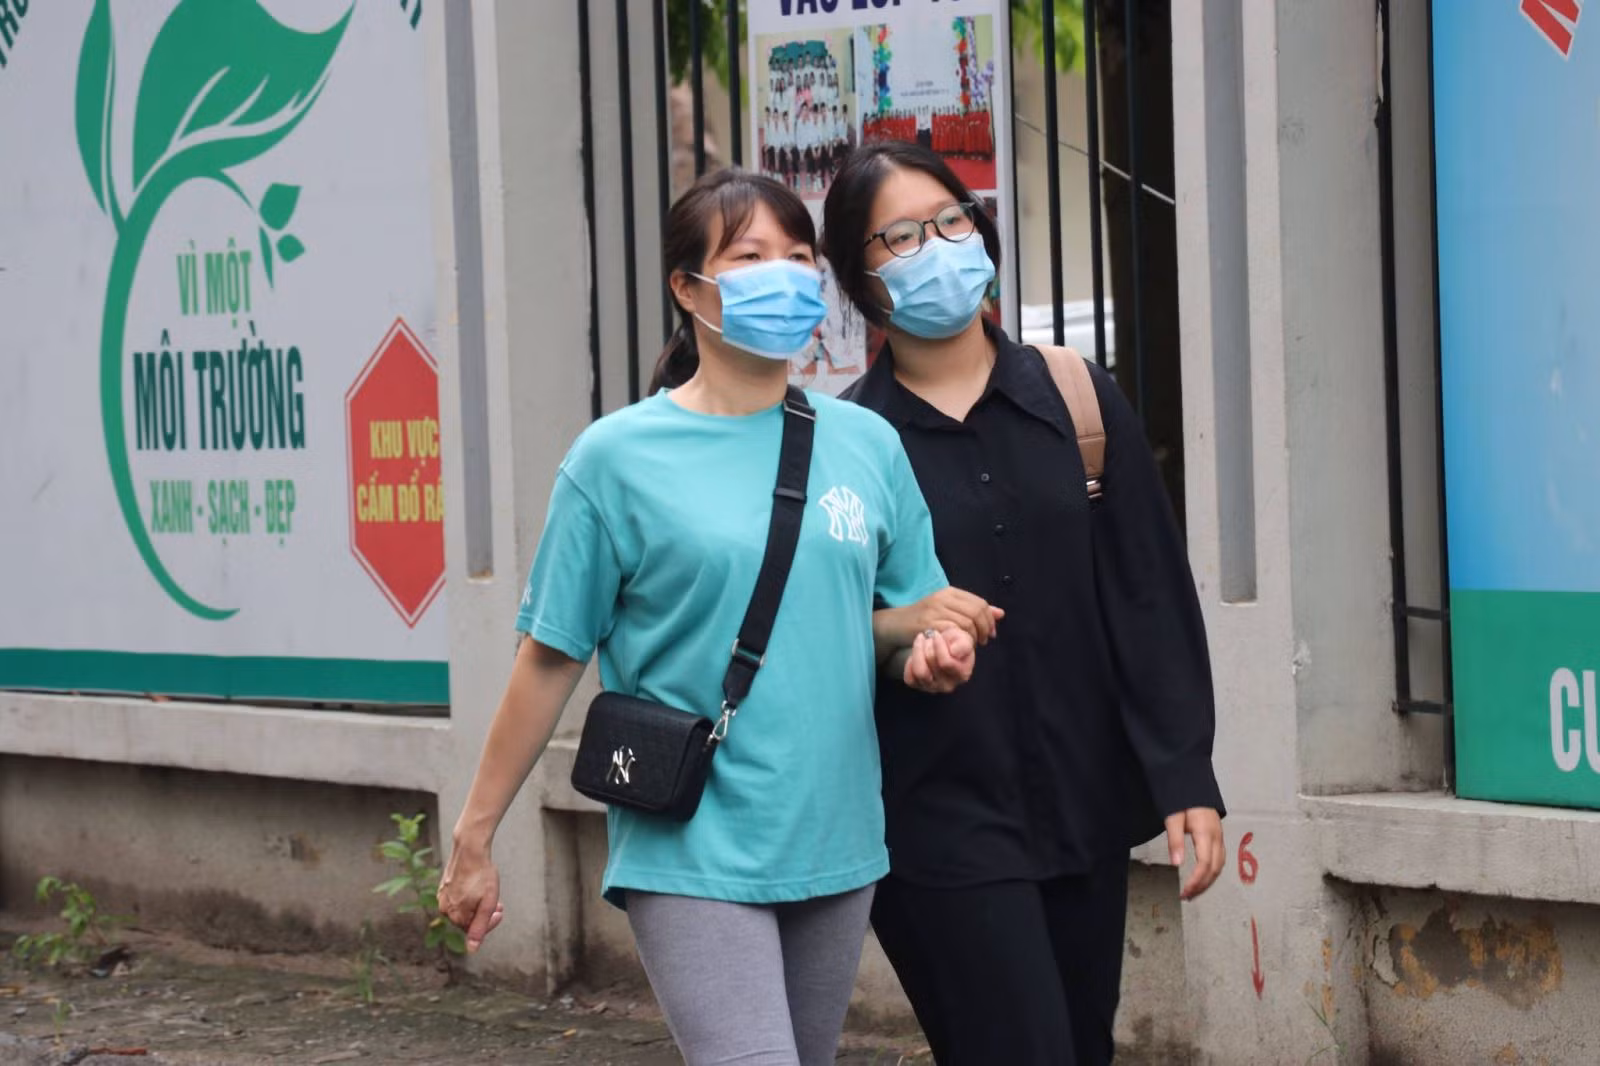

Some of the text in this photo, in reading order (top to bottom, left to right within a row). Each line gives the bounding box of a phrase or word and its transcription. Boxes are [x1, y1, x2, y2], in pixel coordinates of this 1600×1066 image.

[176, 236, 252, 328] VÌ MỘT
[133, 320, 305, 451] MÔI TRƯỜNG
[369, 420, 403, 458] KHU
[150, 479, 193, 533] XANH
[207, 479, 250, 546] SẠCH
[265, 479, 295, 546] ĐẸP
[357, 470, 393, 522] CẤM
[1238, 831, 1258, 885] 6
